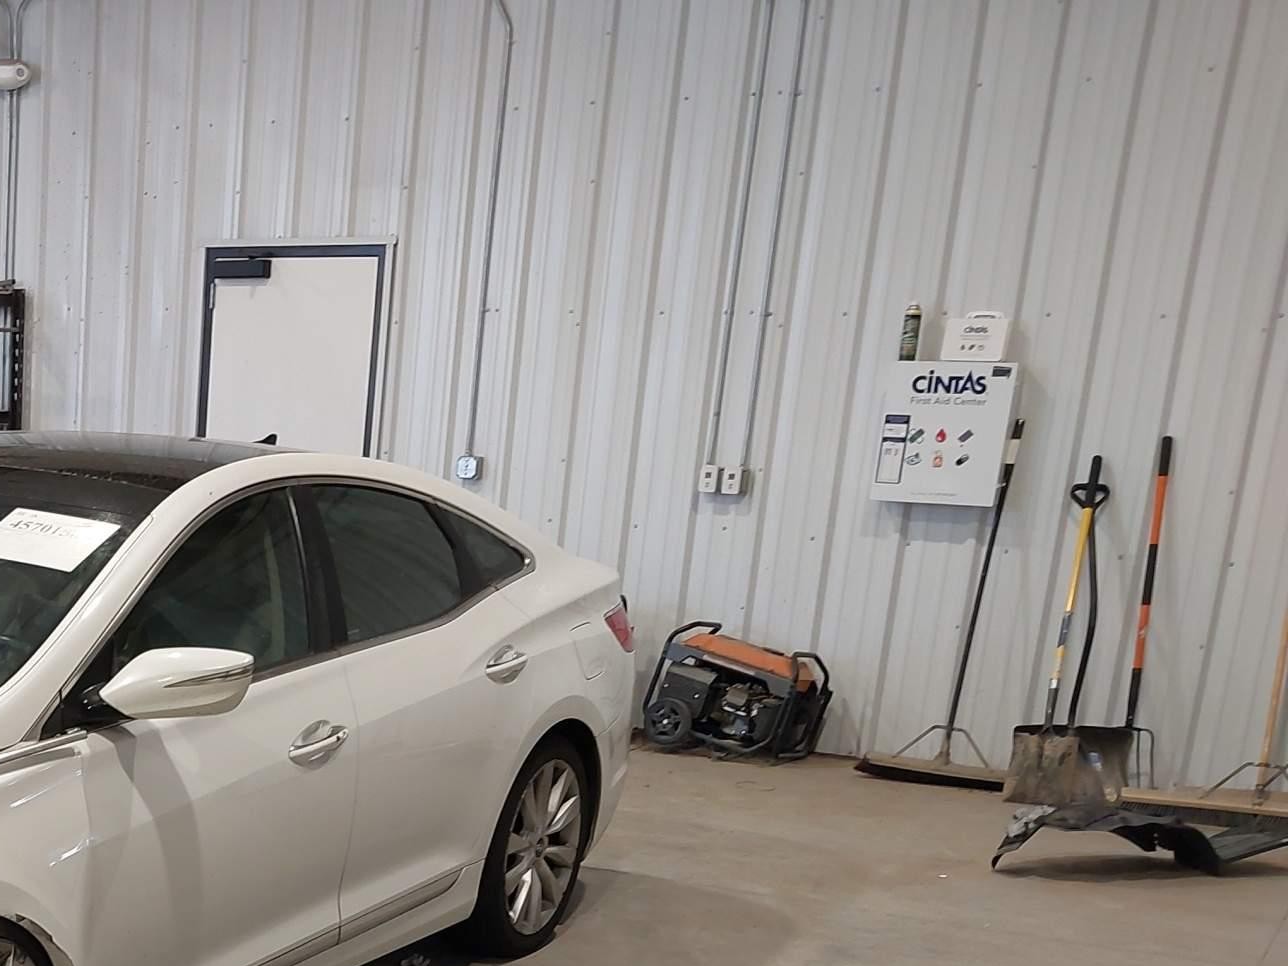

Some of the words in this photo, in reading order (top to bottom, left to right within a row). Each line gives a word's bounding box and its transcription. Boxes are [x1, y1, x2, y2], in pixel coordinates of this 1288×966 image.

[911, 369, 987, 395] CINTAS
[910, 396, 932, 405] First
[933, 396, 951, 406] Aid
[953, 397, 987, 406] Center
